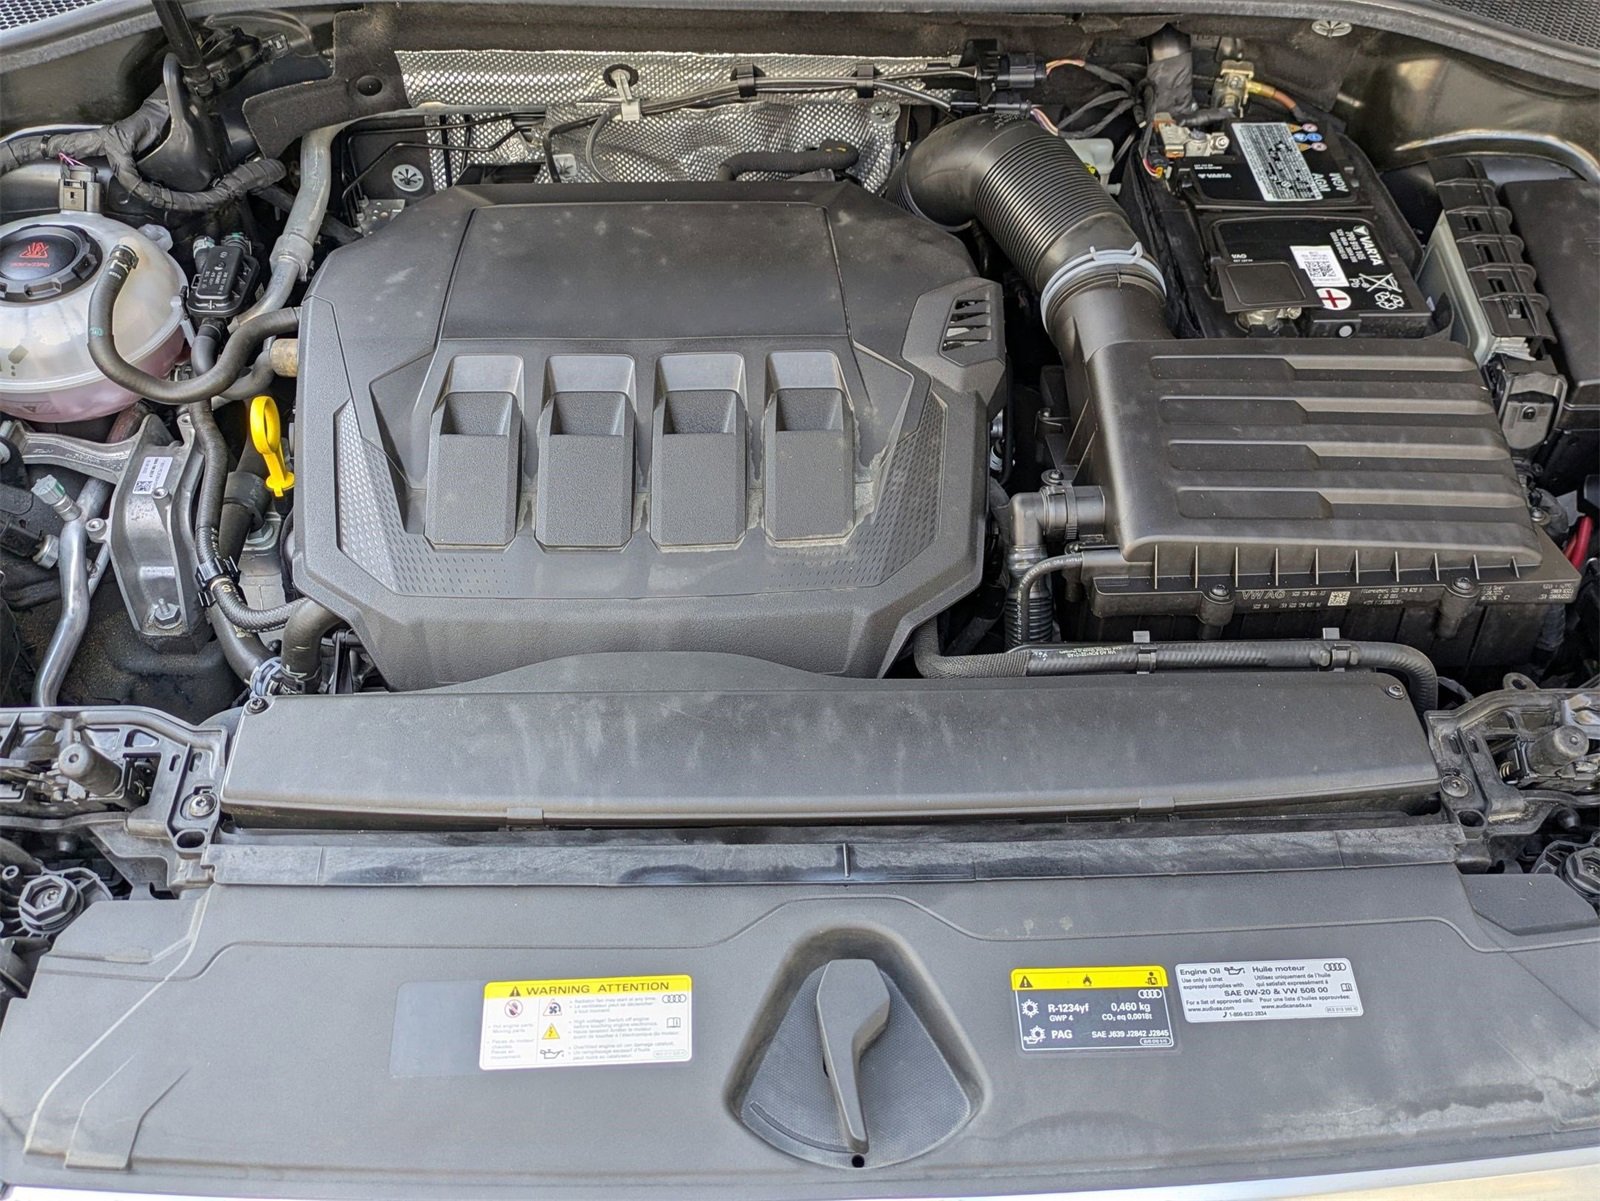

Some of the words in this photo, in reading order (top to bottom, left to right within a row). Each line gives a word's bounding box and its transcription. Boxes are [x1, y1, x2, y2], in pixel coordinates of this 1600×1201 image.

[1359, 235, 1384, 266] VARTA
[1242, 590, 1264, 600] VW
[1264, 590, 1286, 600] AG
[1180, 968, 1208, 977] Engine
[1209, 967, 1221, 975] Oil
[526, 985, 590, 995] WARNING
[597, 981, 670, 993] ATTENTION
[1208, 982, 1232, 990] complies
[1224, 989, 1242, 997] SAE
[1243, 988, 1271, 996] 0W-20
[1047, 1002, 1089, 1014] R-1234yf
[1110, 1002, 1137, 1013] 0,460
[1138, 1001, 1151, 1013] kg
[1049, 1014, 1068, 1022] GWP
[1051, 1029, 1073, 1039] PAG
[1091, 1030, 1107, 1038] SAE
[1107, 1029, 1125, 1038] J639
[1126, 1029, 1147, 1037] J2842
[1148, 1029, 1170, 1037] J2845
